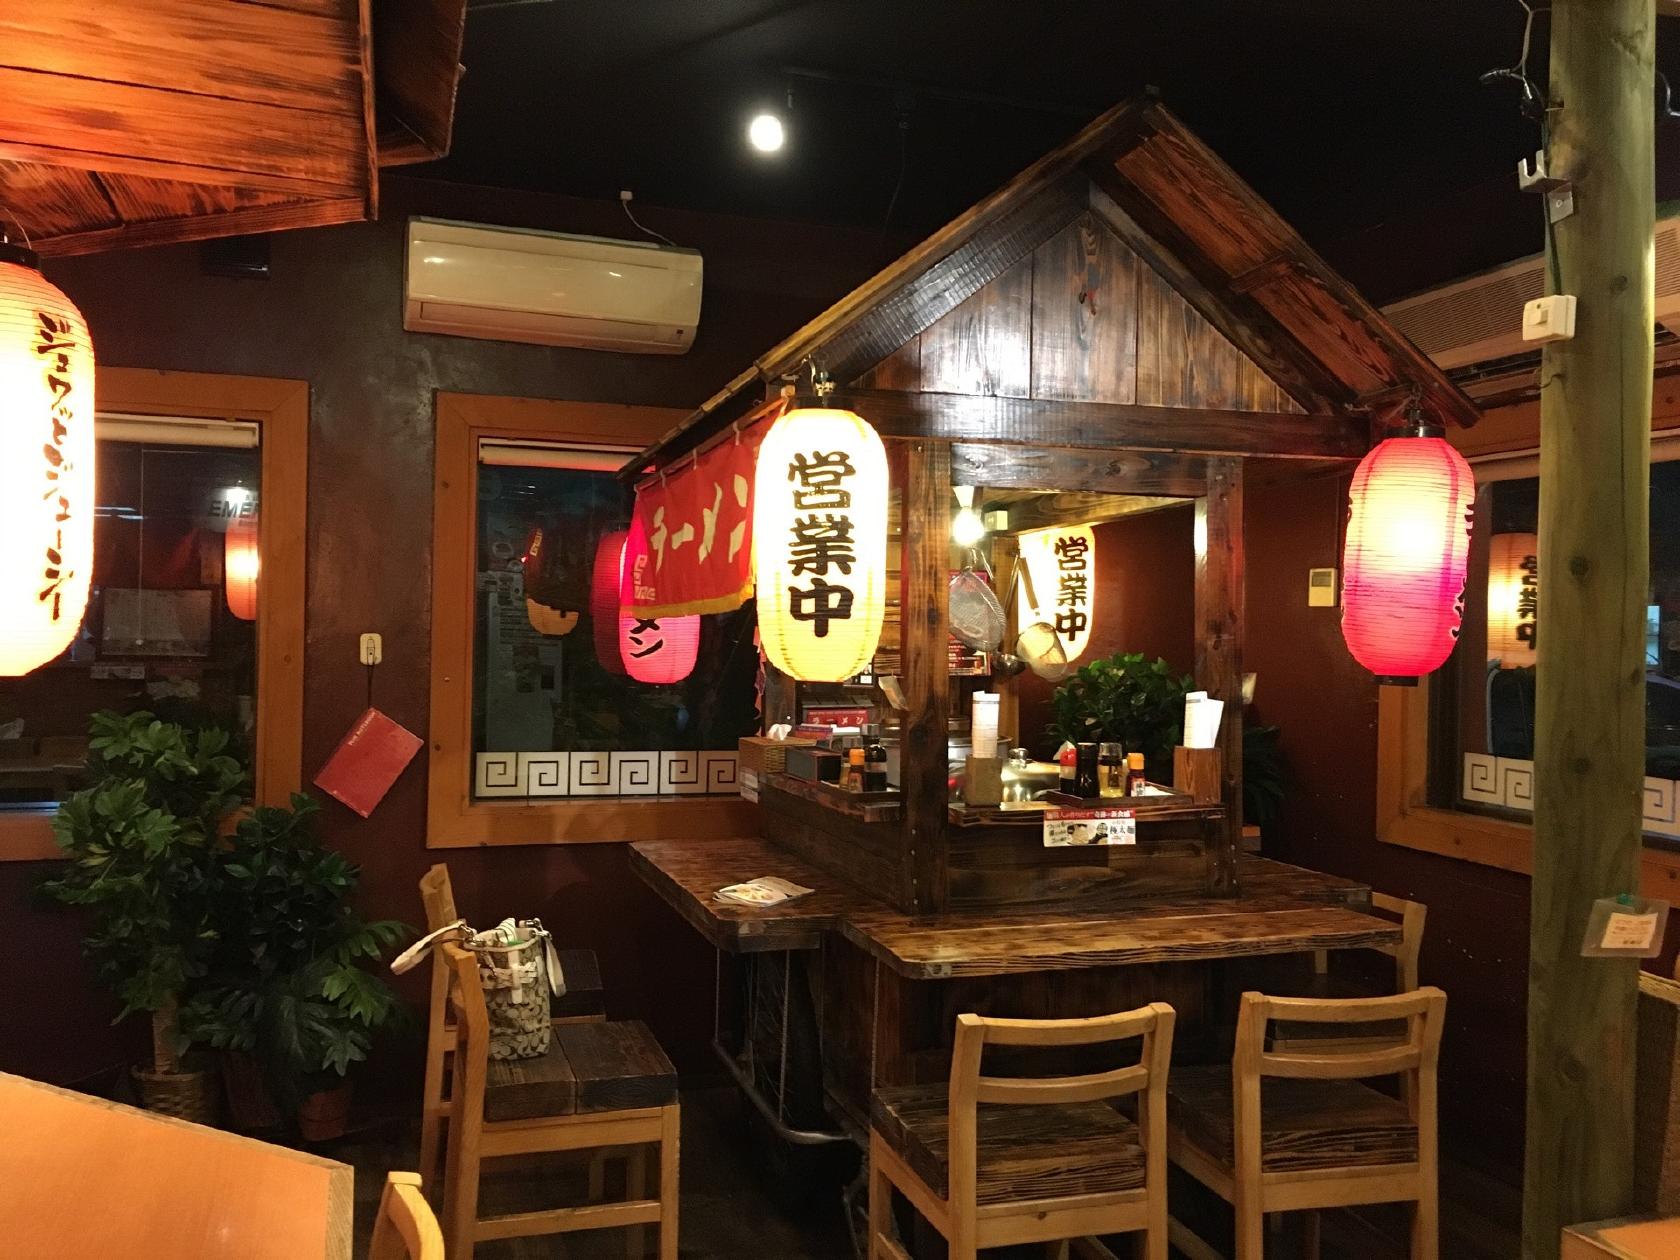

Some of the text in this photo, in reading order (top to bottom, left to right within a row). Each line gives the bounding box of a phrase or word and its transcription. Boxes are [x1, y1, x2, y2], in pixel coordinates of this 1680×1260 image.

[650, 474, 749, 576] ラーメン
[787, 451, 856, 638] 営業中
[1054, 536, 1089, 642] 営業中
[812, 716, 864, 726] ラーメン
